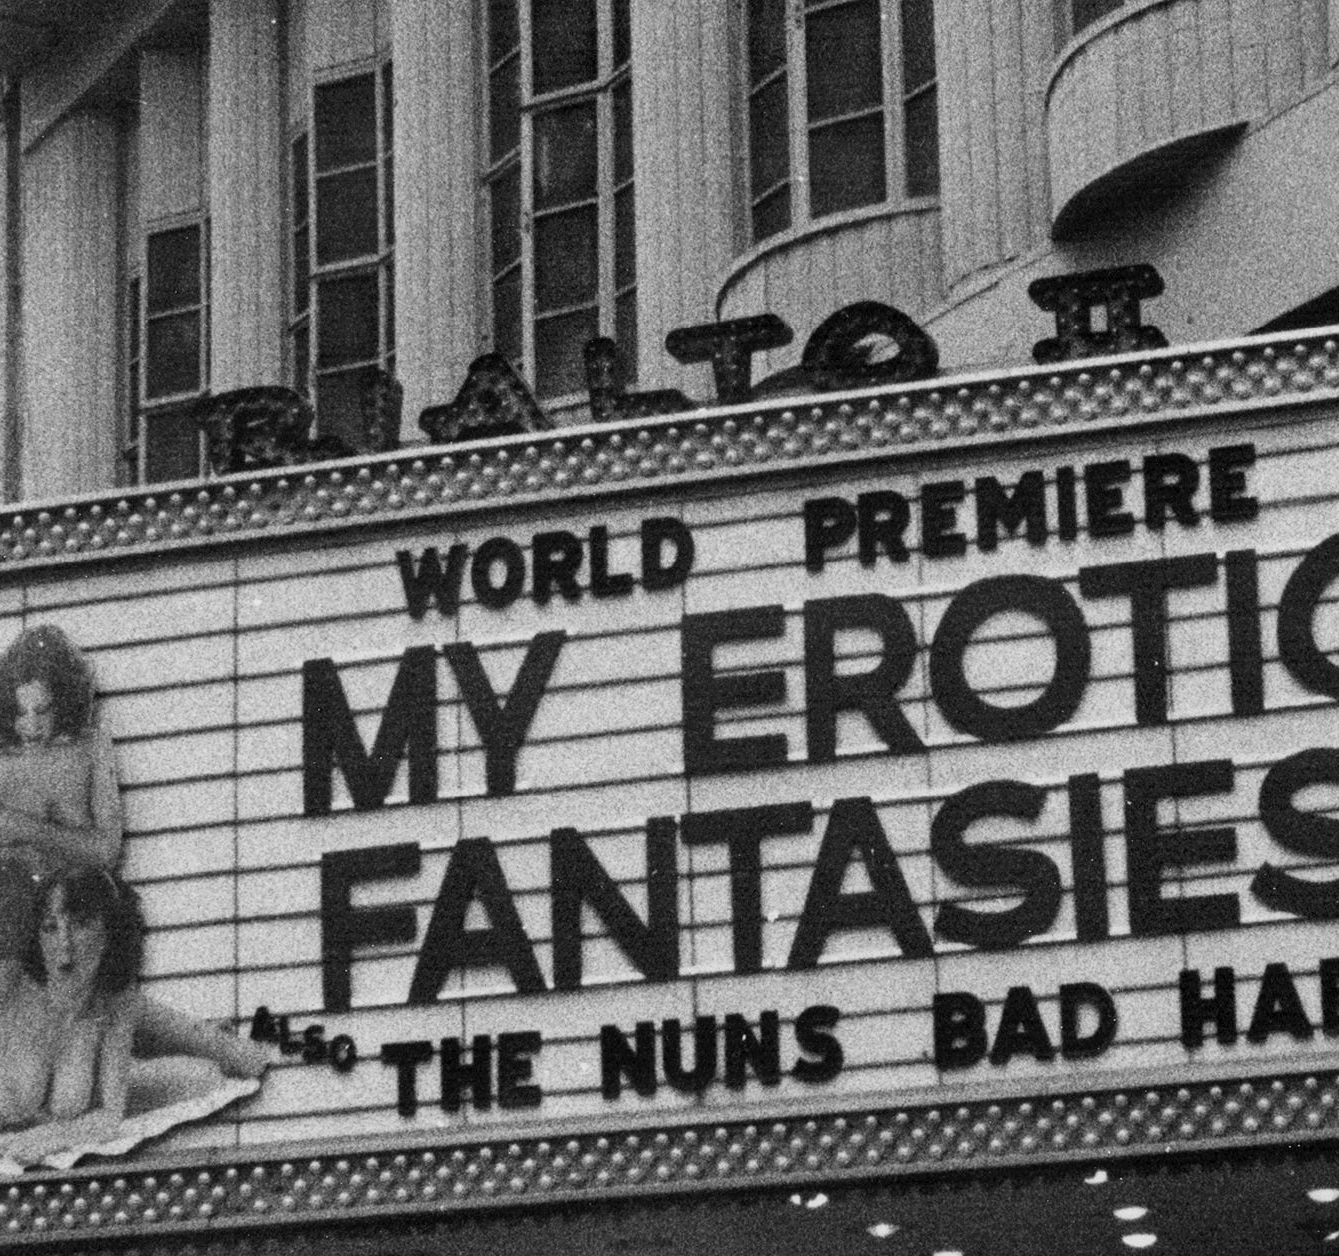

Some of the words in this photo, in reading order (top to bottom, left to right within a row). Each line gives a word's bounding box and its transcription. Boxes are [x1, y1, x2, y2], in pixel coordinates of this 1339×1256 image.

[397, 516, 695, 619] WORLD
[803, 444, 1259, 573] PREMIERE
[303, 629, 567, 817] MY
[250, 1005, 357, 1074] ALSO
[380, 1030, 542, 1118] THE
[600, 1004, 845, 1101] NUNS
[932, 981, 1119, 1072] BAD
